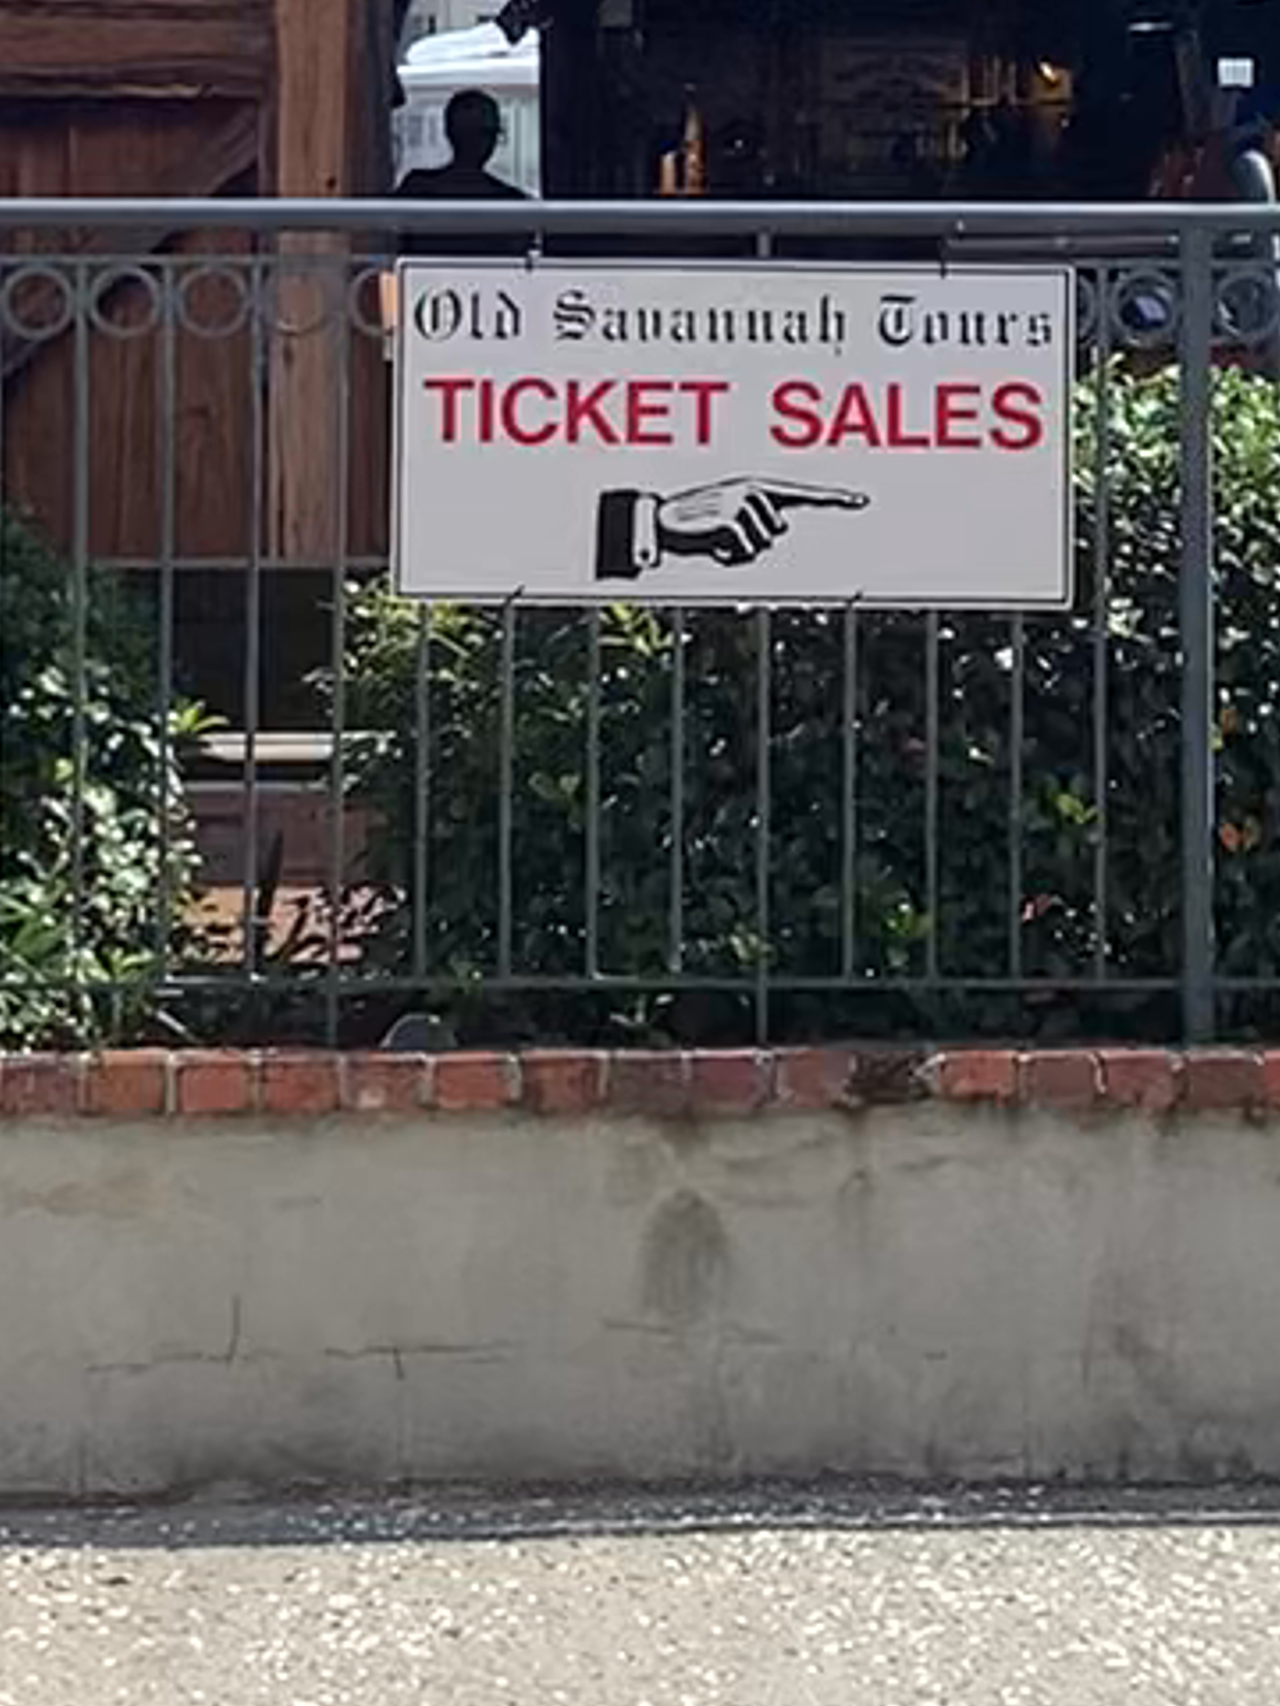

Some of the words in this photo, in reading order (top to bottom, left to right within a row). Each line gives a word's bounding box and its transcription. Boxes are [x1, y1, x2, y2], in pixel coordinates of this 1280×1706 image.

[413, 288, 522, 345] Old
[554, 289, 848, 357] Savannah
[876, 294, 1055, 349] Tours
[422, 376, 730, 445] TICKET
[768, 381, 1044, 451] SALES
